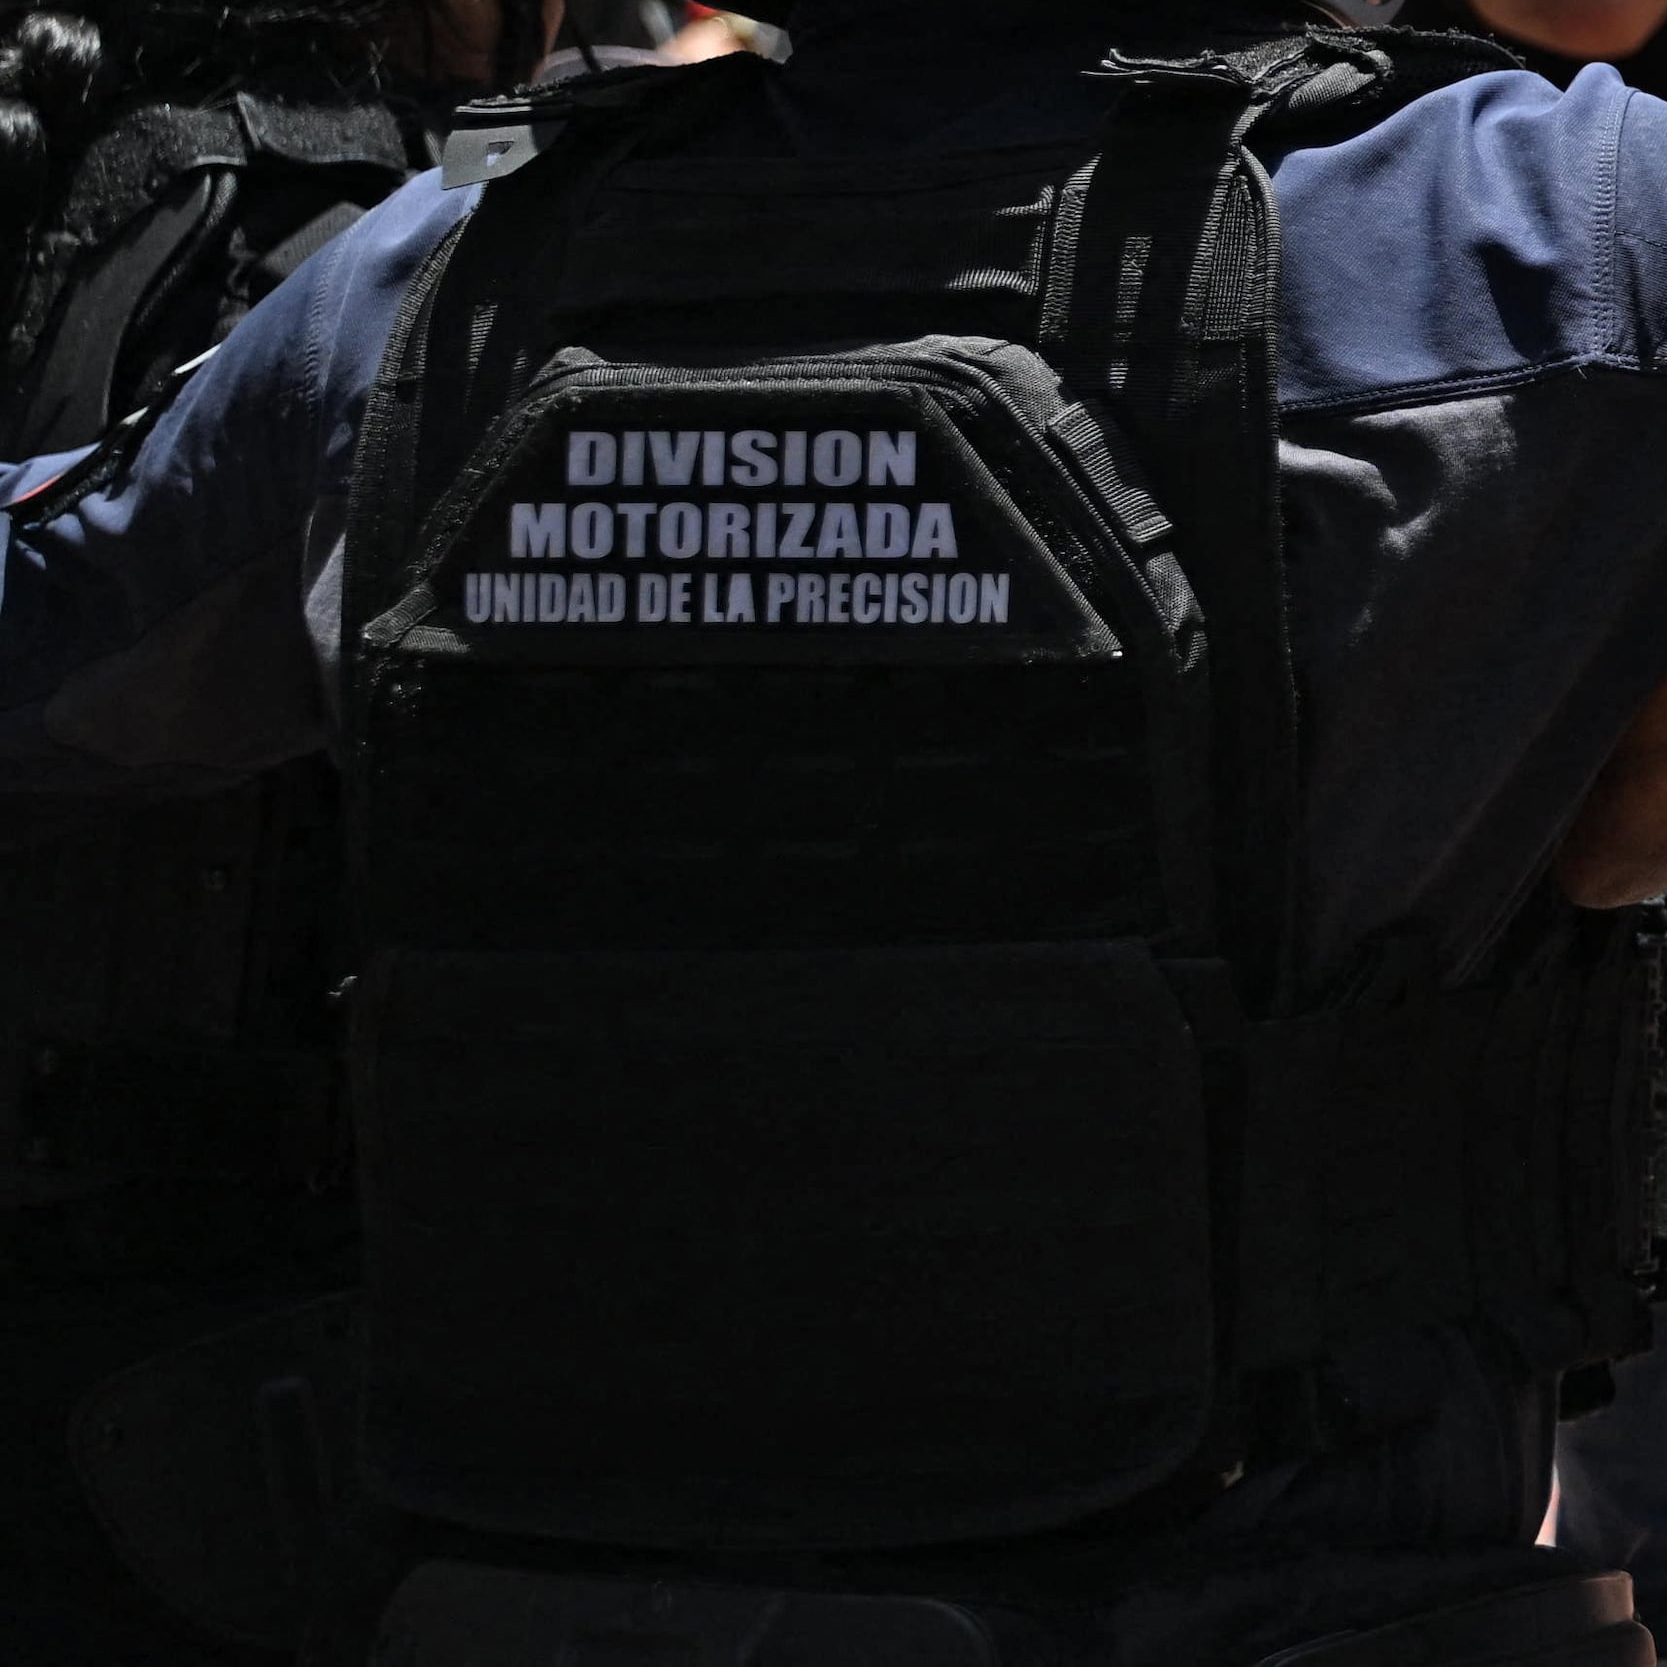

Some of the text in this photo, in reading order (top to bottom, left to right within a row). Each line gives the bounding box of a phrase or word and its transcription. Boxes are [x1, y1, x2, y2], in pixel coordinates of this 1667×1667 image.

[567, 430, 918, 487] DIVISION
[509, 502, 959, 560] MOTORIZADA
[465, 572, 1010, 624] UNIDAD DE LA PRECISION
